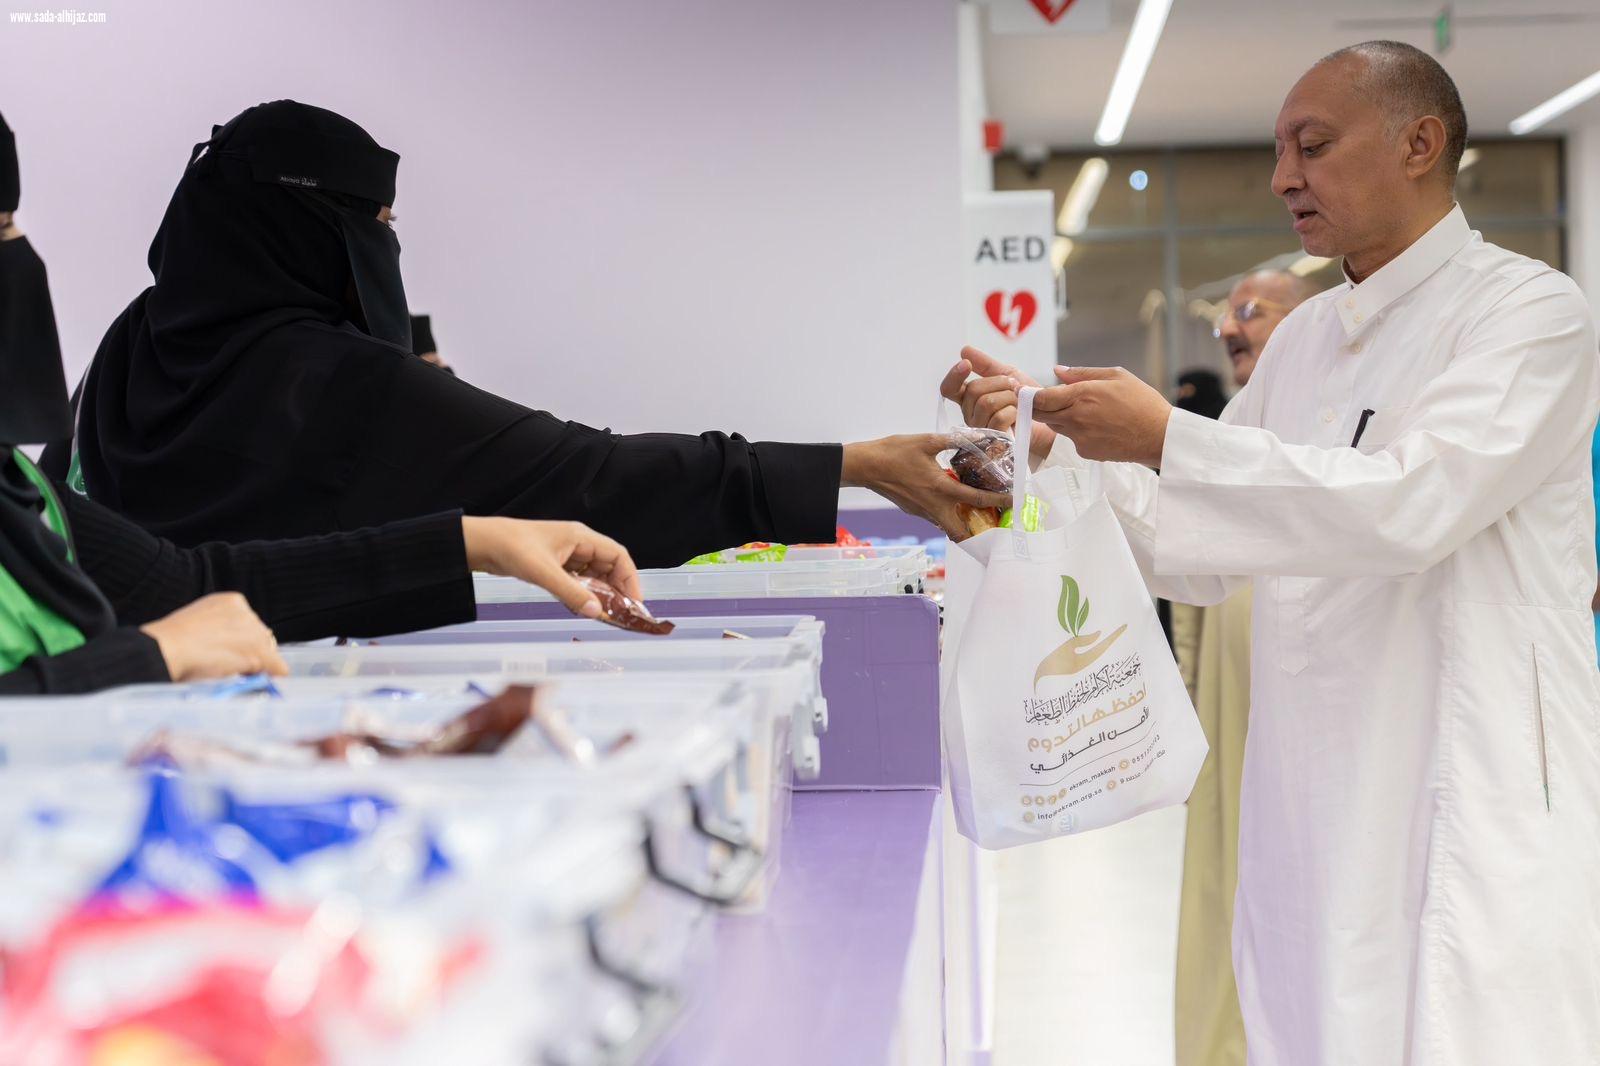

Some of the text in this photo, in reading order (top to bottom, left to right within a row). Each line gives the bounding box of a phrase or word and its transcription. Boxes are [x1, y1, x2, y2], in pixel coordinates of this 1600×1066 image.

[975, 236, 1046, 263] AED
[1030, 731, 1106, 774] الغذائي
[1069, 766, 1116, 791] ekram_makkah
[1037, 789, 1103, 820] info@ekram.org.sa
